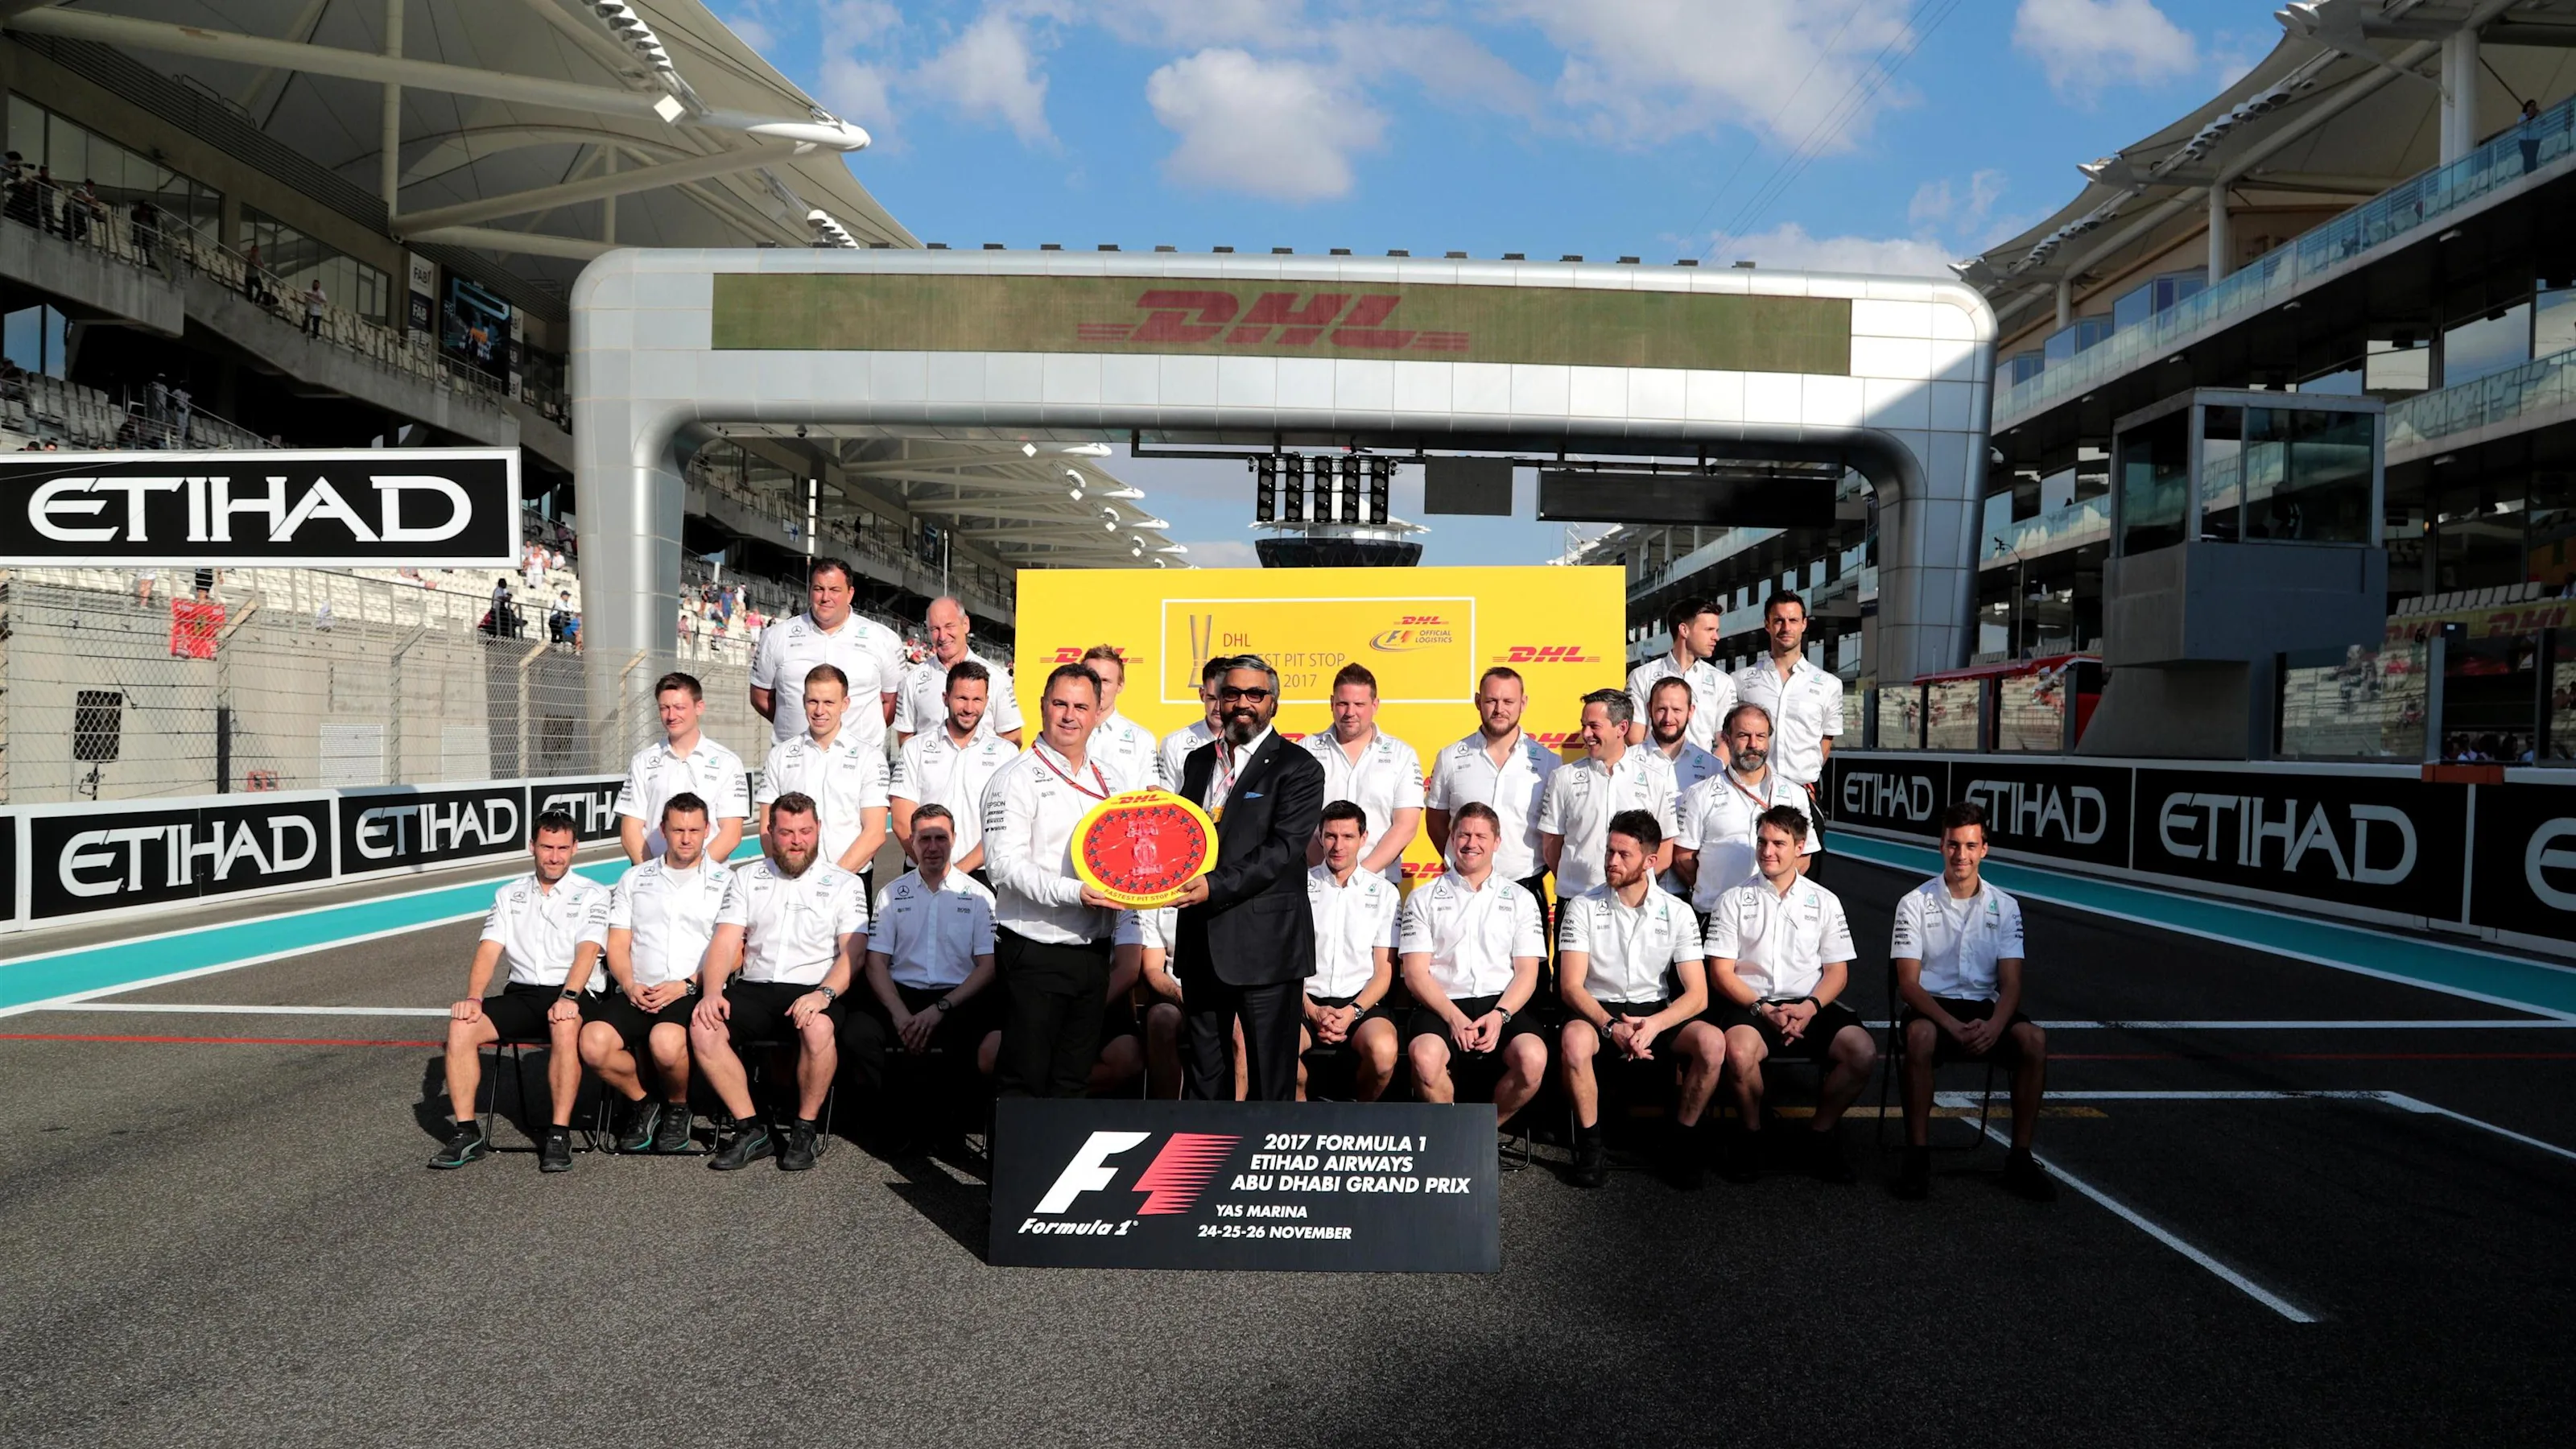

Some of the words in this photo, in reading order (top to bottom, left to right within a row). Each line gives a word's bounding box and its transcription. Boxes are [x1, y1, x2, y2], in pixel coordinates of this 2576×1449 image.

[1129, 290, 1418, 349] DHL
[27, 476, 473, 543] ETIHAD
[1402, 616, 1441, 625] DHL
[1223, 634, 1251, 647] DHL
[1285, 653, 1305, 667] PIT
[1309, 653, 1345, 667] STOP
[1508, 646, 1585, 662] DHL
[1284, 674, 1317, 687] 2017
[1120, 795, 1159, 803] DHL
[1843, 772, 1933, 821] ETIHAD
[1964, 779, 2107, 844] ETIHAD
[355, 801, 519, 861] ETIHAD
[2159, 789, 2417, 884] ETIHAD
[59, 815, 317, 896] ETIHAD
[1402, 863, 1446, 878] DH
[1104, 889, 1135, 901] FASTEST
[1150, 893, 1169, 901] STOP
[1264, 1134, 1311, 1151] 2017
[1315, 1135, 1412, 1151] FORMULA
[1418, 1137, 1427, 1152] 1
[1250, 1154, 1319, 1171] ETIHAD
[1323, 1155, 1414, 1172] AIRWAYS
[1033, 1131, 1244, 1215] F1
[1230, 1174, 1274, 1191] ABU
[1278, 1175, 1340, 1192] DHABI
[1346, 1176, 1419, 1193] GRAND
[1424, 1177, 1471, 1194] PRIX
[1216, 1204, 1243, 1217] YAS
[1246, 1205, 1308, 1218] MARINA
[1018, 1218, 1115, 1236] Formula
[1197, 1225, 1265, 1239] 24-25-26
[1269, 1226, 1352, 1240] NOVEMBER
